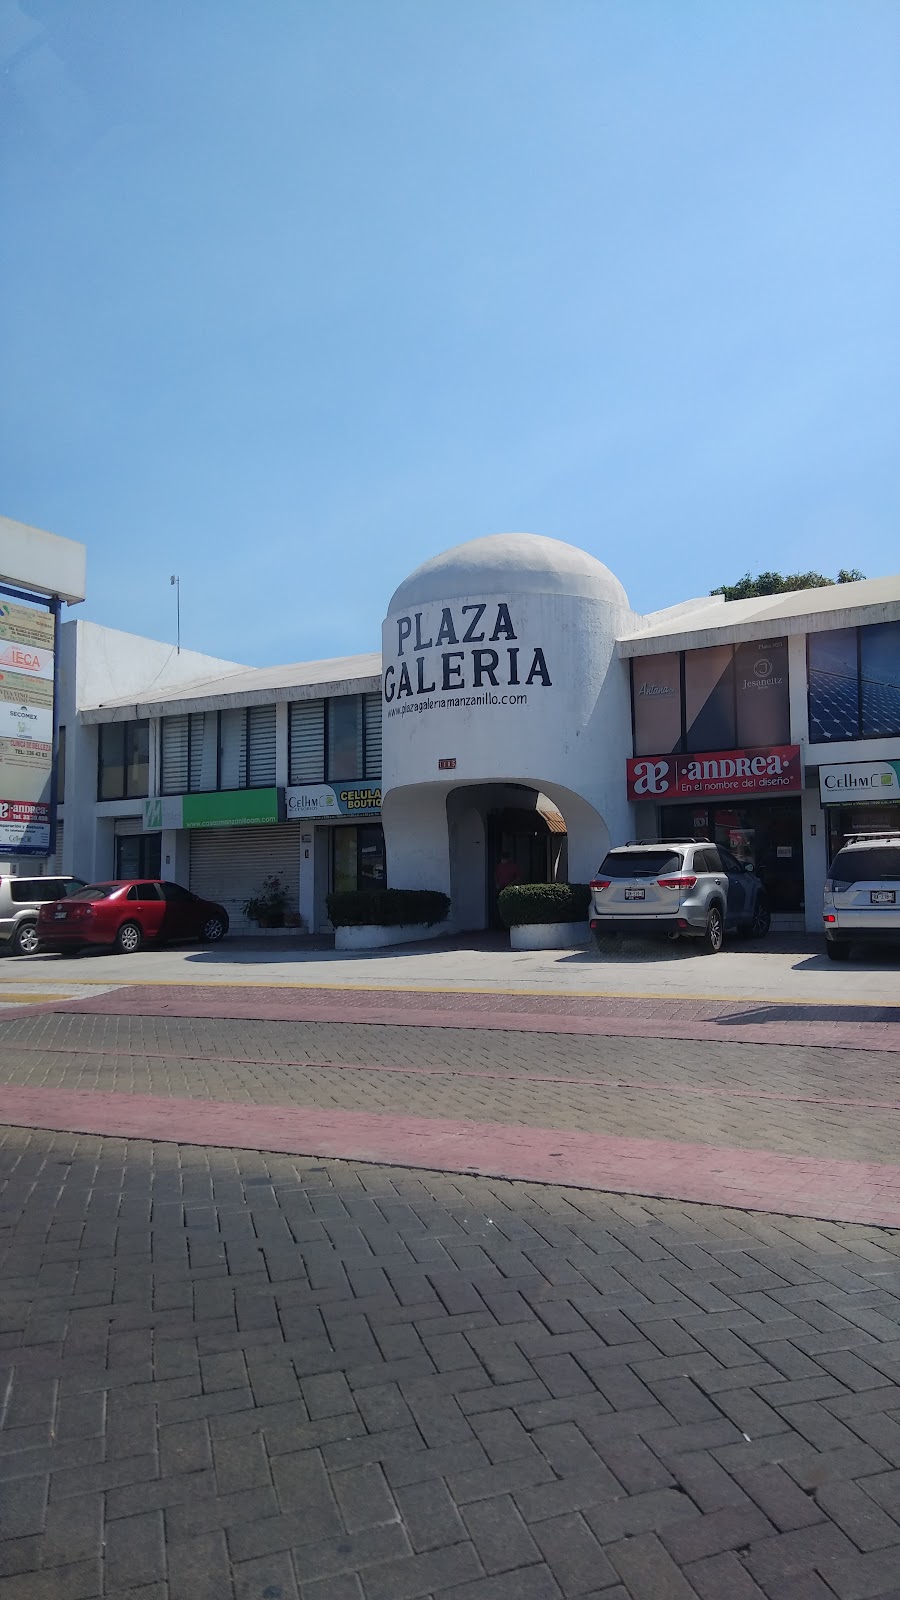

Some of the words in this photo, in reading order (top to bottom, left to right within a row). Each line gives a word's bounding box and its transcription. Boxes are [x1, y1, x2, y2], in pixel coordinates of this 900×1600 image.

[397, 603, 518, 657] PLAZA
[12, 651, 41, 668] IECA
[384, 648, 553, 703] GALERIA
[10, 710, 38, 720] SECOMEX
[387, 692, 527, 718] www.plazagaleriamanzanillo.com
[681, 783, 692, 792] En
[694, 782, 703, 791] el
[704, 780, 739, 791] nombre
[742, 778, 756, 788] del
[759, 776, 790, 787] diseño
